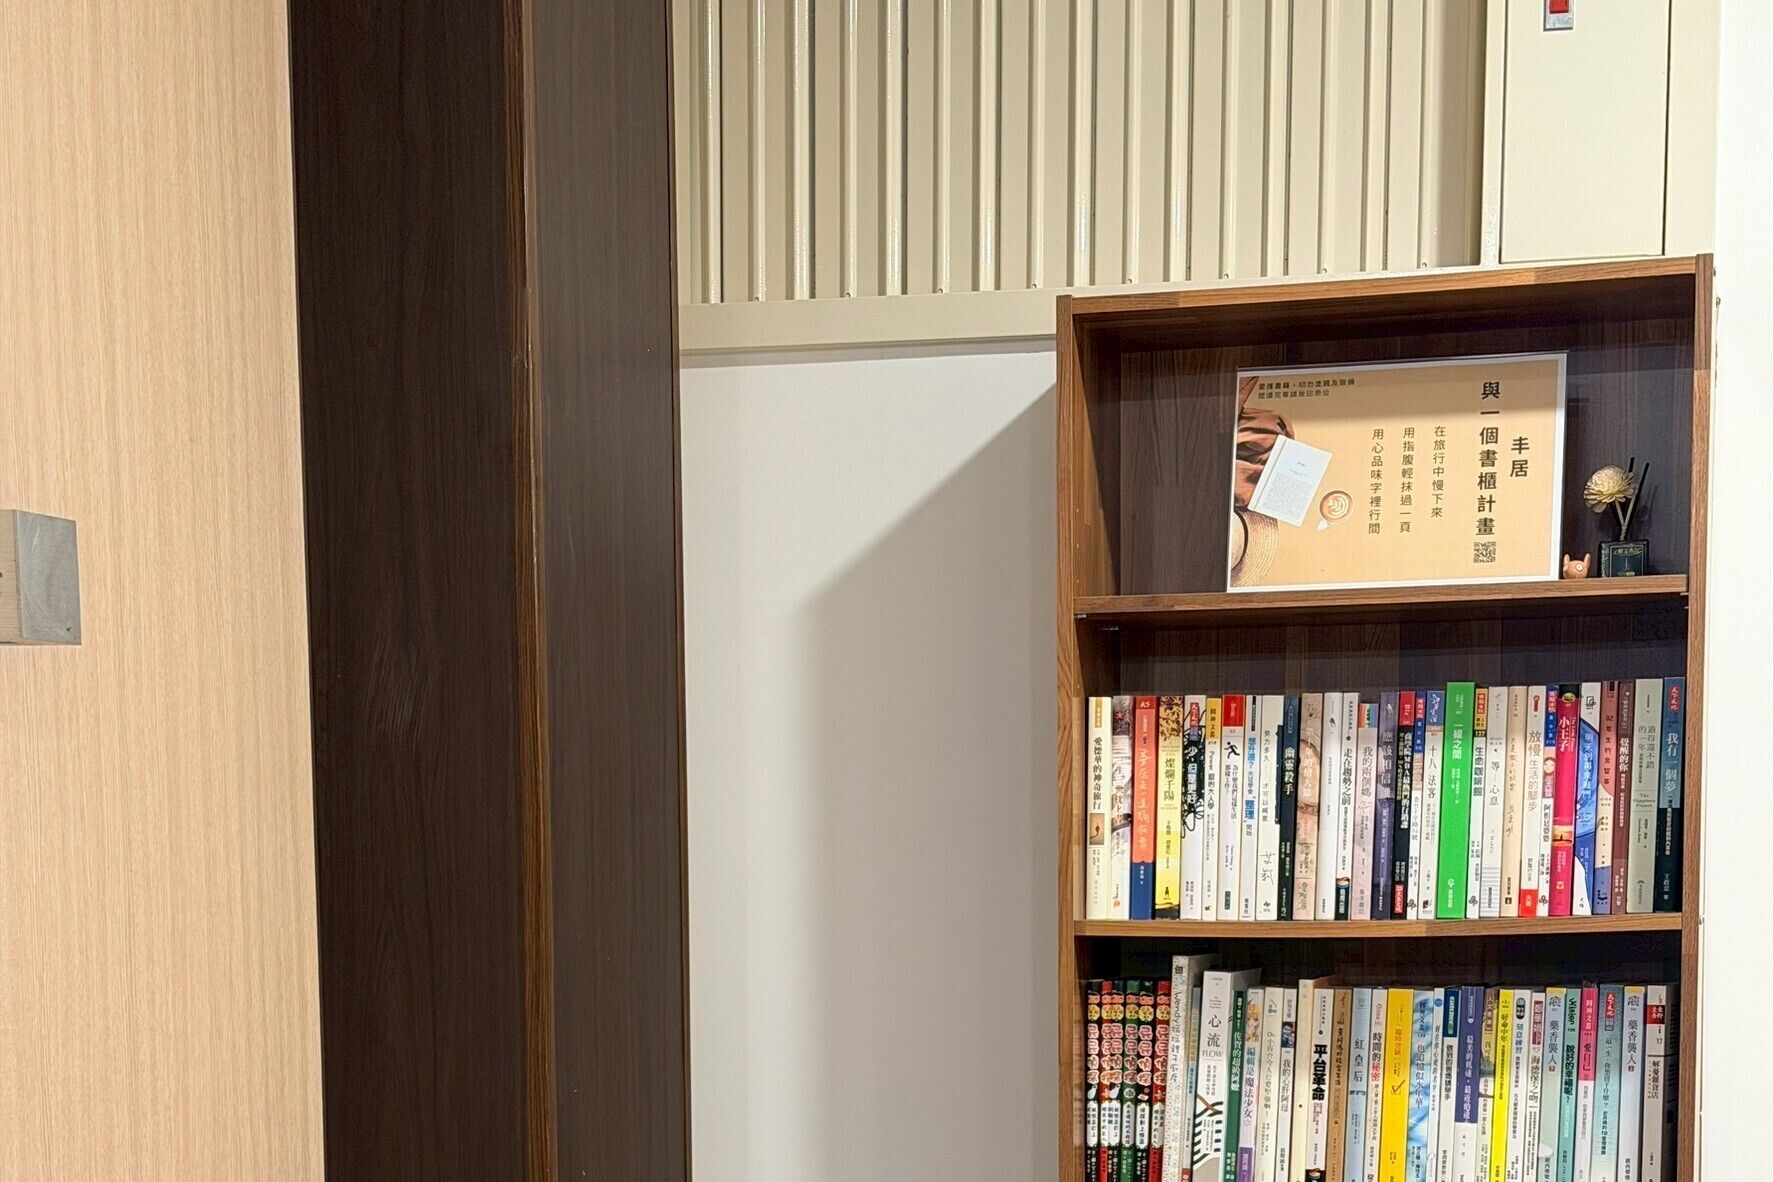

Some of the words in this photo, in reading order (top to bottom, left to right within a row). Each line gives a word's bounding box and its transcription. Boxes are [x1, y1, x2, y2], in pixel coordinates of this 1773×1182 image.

[1368, 428, 1384, 535] 用心品味字裡行間
[1399, 427, 1415, 533] 用指腹輕抹過一頁
[1431, 425, 1446, 518] 在旅行中慢下來
[1475, 381, 1501, 536] 與一個書櫃計畫
[1509, 436, 1530, 478] 丰居
[1559, 716, 1570, 752] 小王子
[1603, 714, 1614, 785] 82年生的金智英
[1664, 732, 1679, 792] 我有一個夢
[1093, 736, 1103, 811] 愛德華的神奇旅行
[1163, 758, 1176, 801] 燦爛千陽
[1202, 1049, 1223, 1058] FLOW
[1206, 1013, 1222, 1048] 心流
[1311, 1043, 1328, 1102] 平台革命
[1651, 1060, 1661, 1099] 解憂雜貨店
